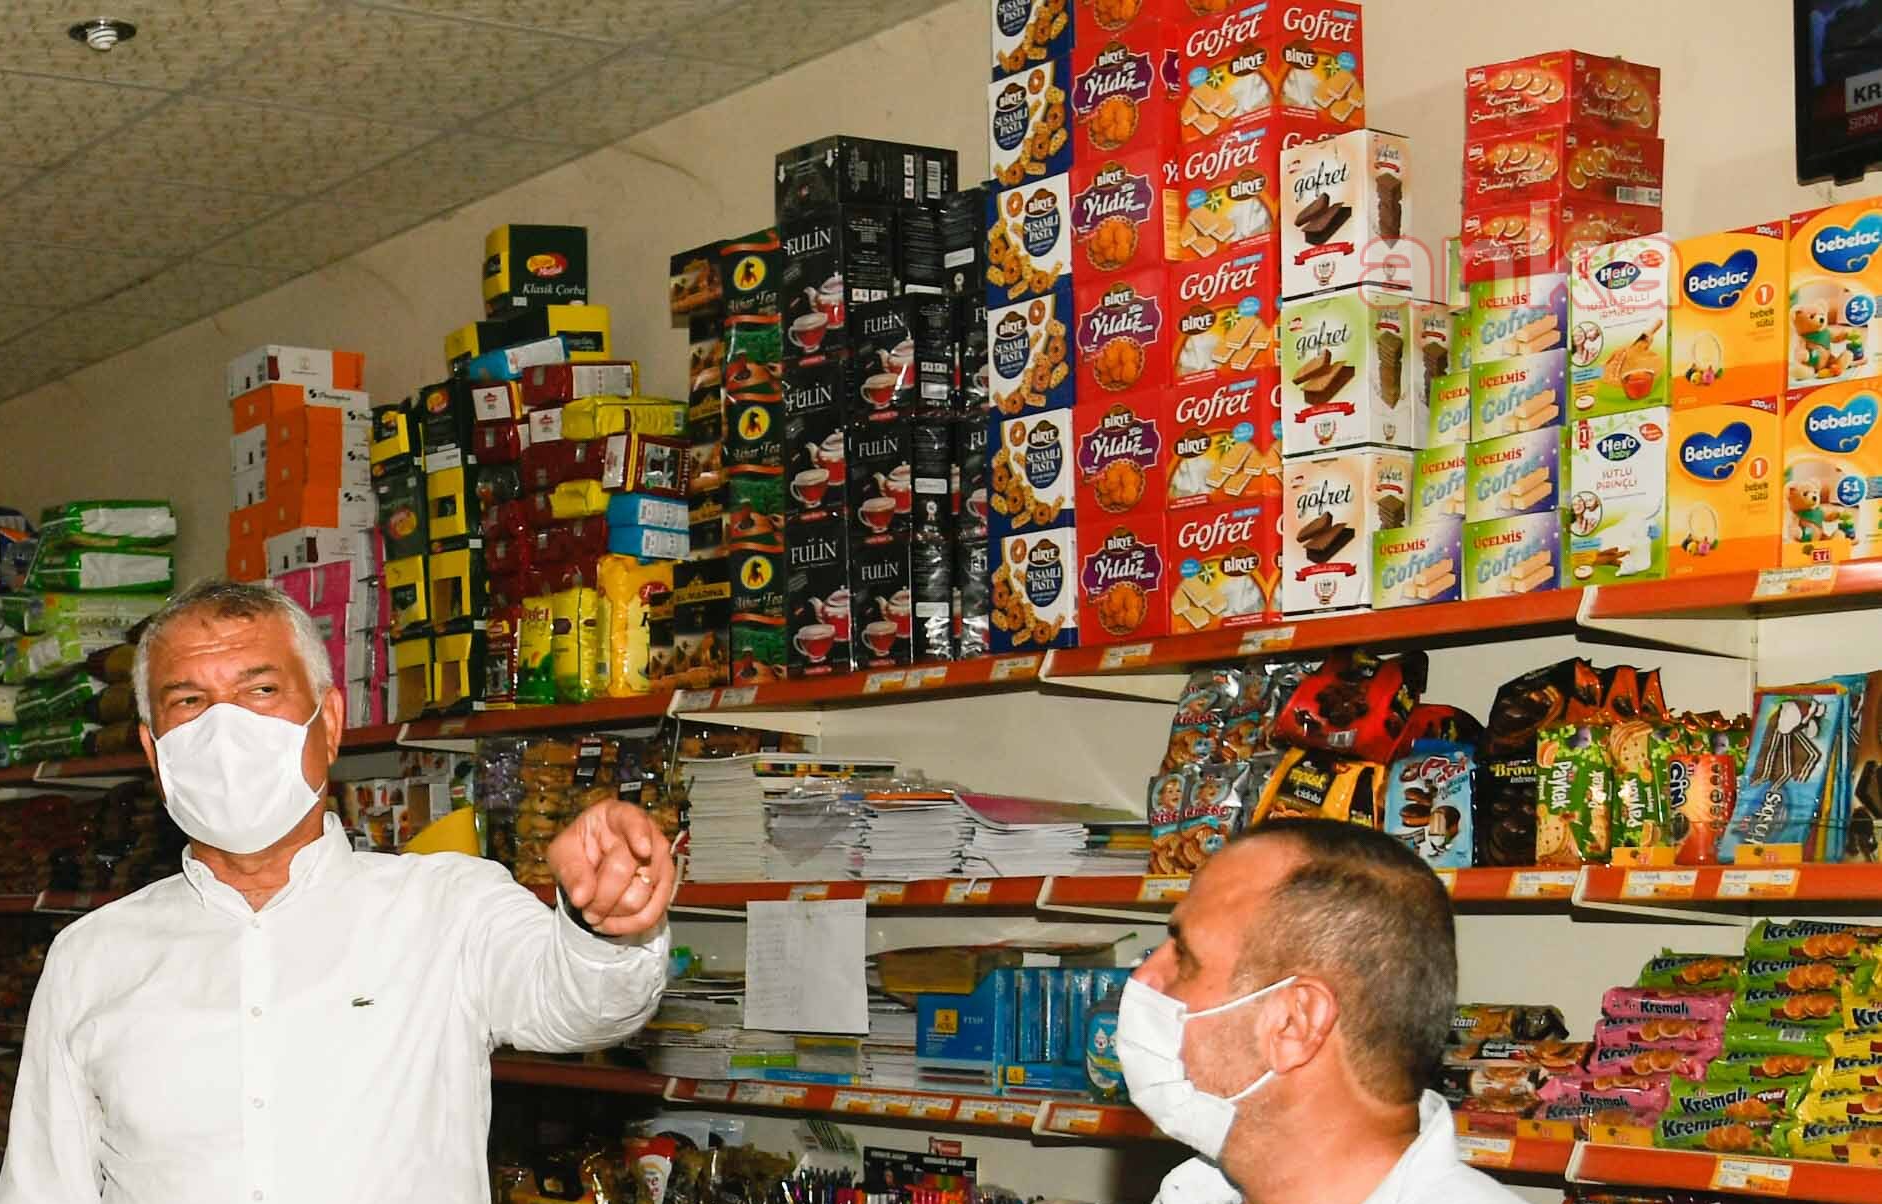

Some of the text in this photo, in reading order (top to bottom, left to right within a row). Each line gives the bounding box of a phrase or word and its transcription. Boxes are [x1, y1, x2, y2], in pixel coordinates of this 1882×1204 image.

[1003, 5, 1026, 21] PASTA
[1186, 14, 1262, 58] Gofret
[1283, 7, 1355, 43] Gofret
[1232, 52, 1267, 74] BİRYE
[1285, 48, 1315, 68] BİRYE
[1084, 69, 1137, 103] Yıldız
[1854, 83, 1882, 105] KR
[999, 118, 1023, 137] PASTA
[1184, 138, 1261, 182] Gofret
[1231, 178, 1265, 199] BİRYE
[1294, 160, 1350, 203] gofret
[1083, 189, 1136, 223] Yıldız
[1024, 214, 1059, 233] SUSAMLI
[1029, 226, 1054, 243] PASTA
[1815, 230, 1881, 255] bebelac
[1180, 259, 1261, 302] Gofret
[1599, 265, 1638, 282] Hero
[1688, 268, 1749, 294] Bebelac
[522, 282, 587, 298] Klasik Çorba
[1760, 286, 1768, 303] 1
[1181, 315, 1215, 333] BİRYE
[1749, 307, 1775, 320] bebek
[1090, 310, 1143, 343] Yıldız
[1295, 320, 1349, 361] gofret
[999, 350, 1023, 364] PASTA
[1176, 381, 1254, 426] Gofret
[1438, 386, 1470, 403] ÜÇELM
[1438, 398, 1470, 433] Gof
[1808, 411, 1873, 433] bebelac
[858, 436, 900, 458] FULİN
[1026, 448, 1061, 464] SUSAMLI
[1090, 433, 1143, 464] Yıldız
[1177, 438, 1210, 455] BİRYE
[1599, 437, 1638, 453] Hero
[1684, 441, 1744, 463] Bebelac
[1031, 461, 1056, 474] PASTA
[1755, 459, 1763, 477] 1
[1296, 479, 1353, 519] gofret
[1422, 472, 1465, 508] Gofr
[1178, 515, 1255, 552] Gofret
[790, 545, 839, 566] FULİN
[1223, 556, 1257, 573] BİRYE
[861, 559, 900, 582] FULİN
[1026, 566, 1061, 582] SUSAMLI
[1095, 554, 1145, 586] Yıldız
[1031, 578, 1056, 592] PASTA
[1551, 761, 1574, 810] Paykek
[1640, 1000, 1690, 1016] Kremalı
[1679, 1086, 1750, 1116] Kremalı
[1758, 1089, 1786, 1102] Yeni
